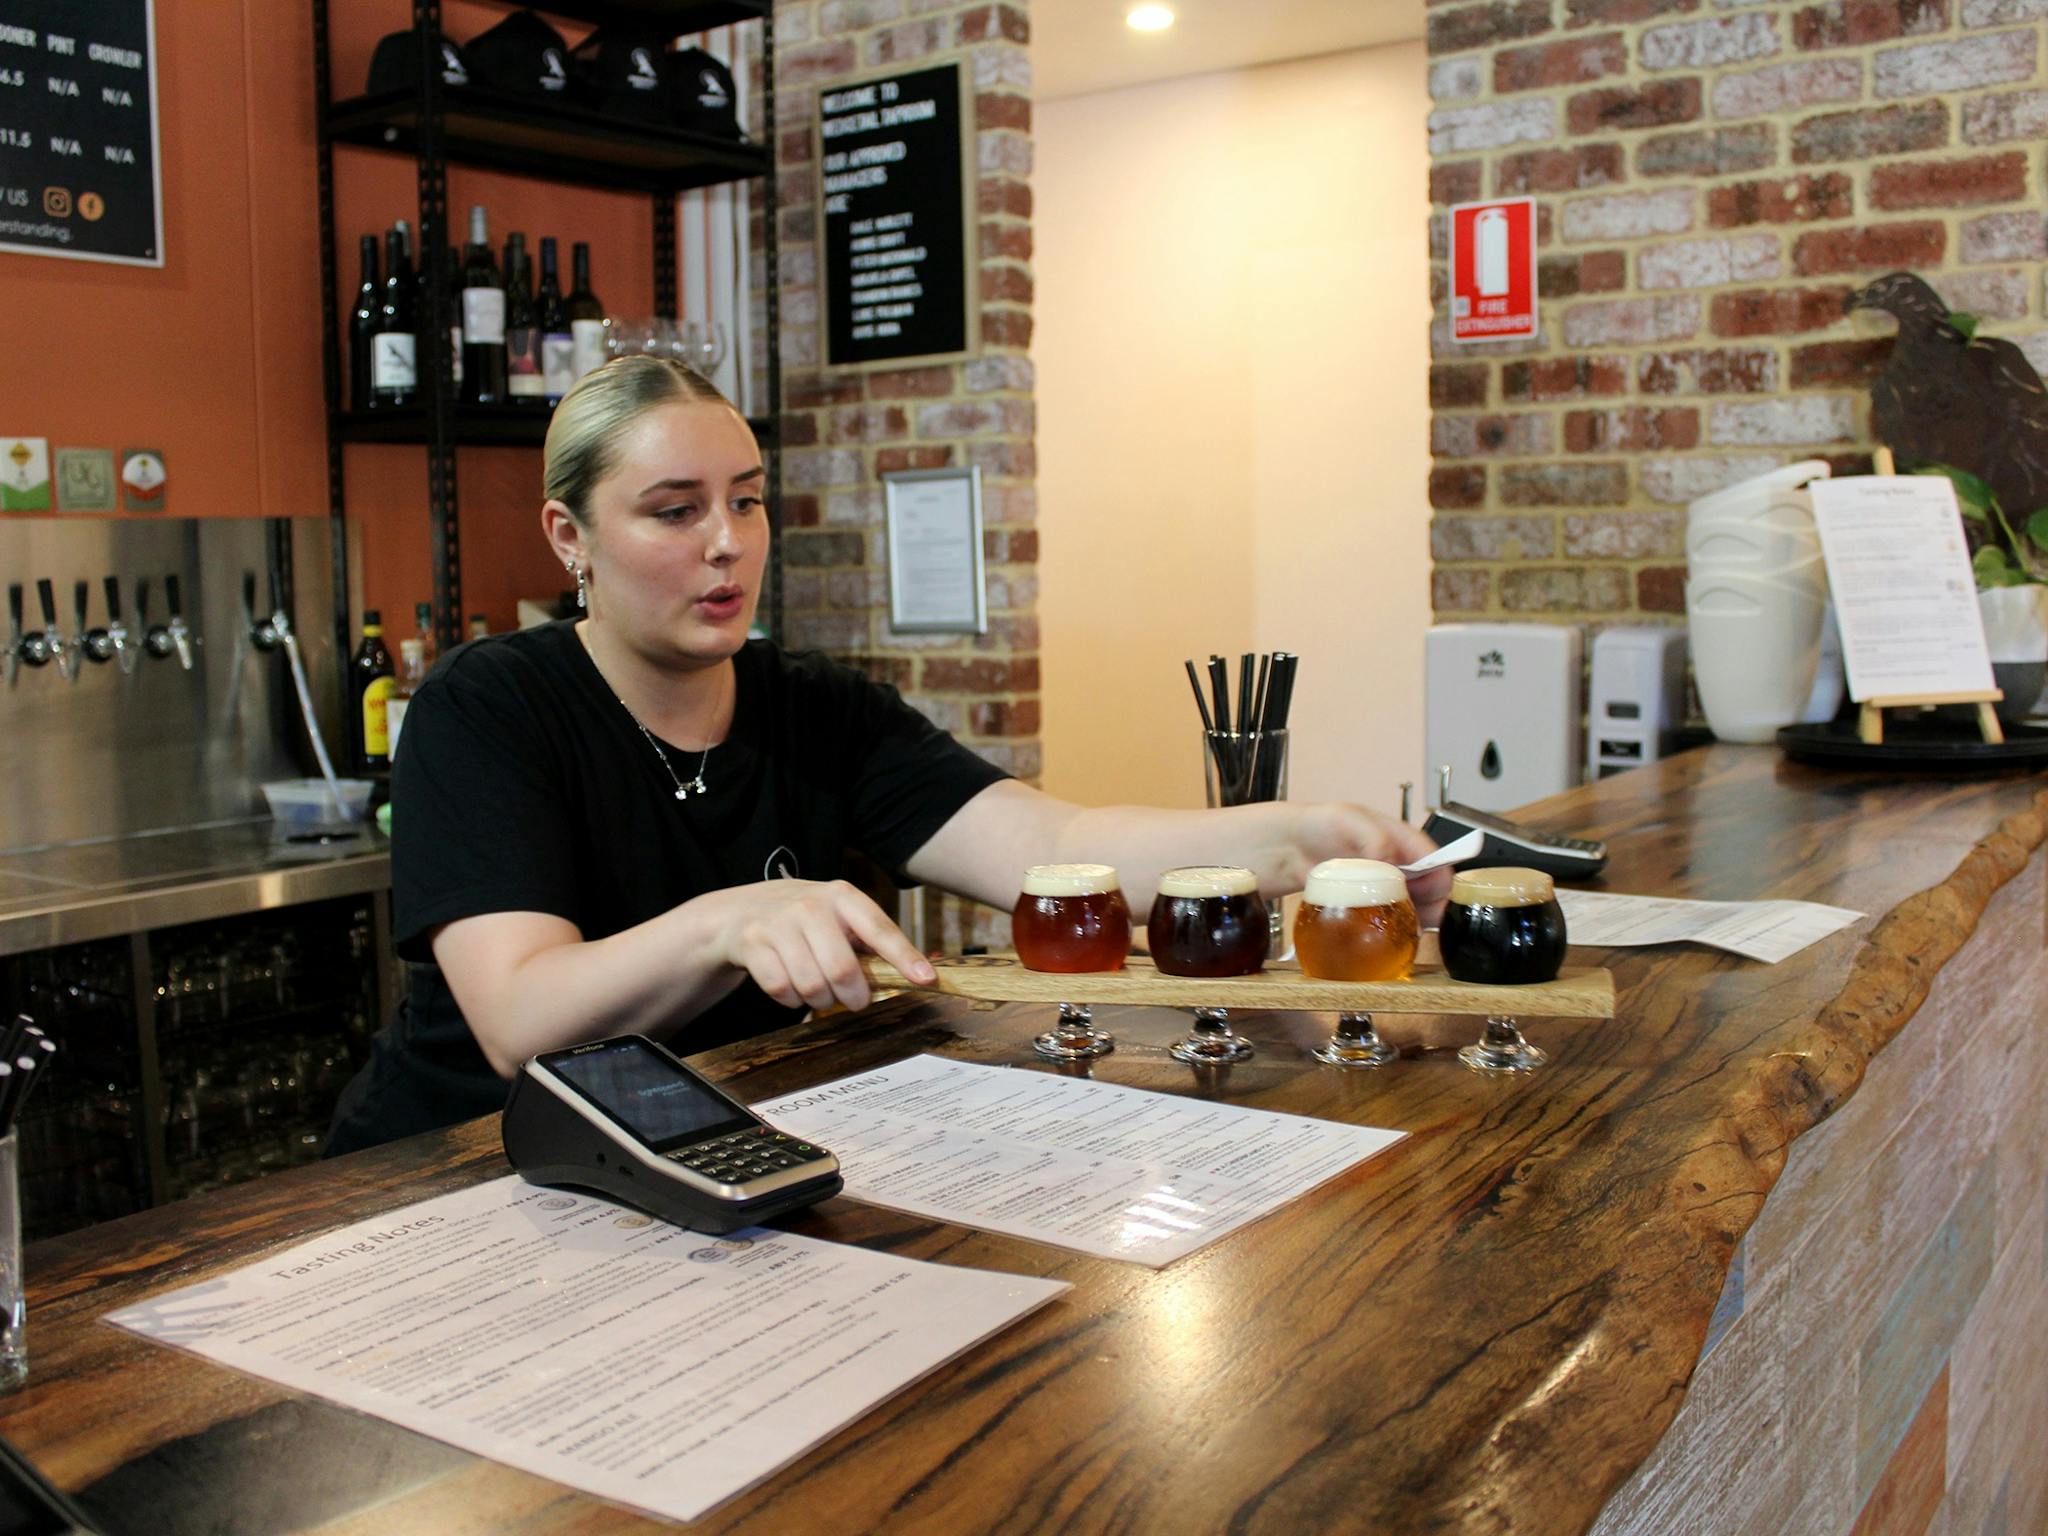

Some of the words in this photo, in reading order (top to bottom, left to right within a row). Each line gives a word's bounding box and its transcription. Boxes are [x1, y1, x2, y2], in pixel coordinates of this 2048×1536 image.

[48, 76, 80, 97] N/A
[102, 86, 133, 107] N/A
[50, 136, 82, 156] N/A
[104, 145, 136, 164] N/A
[1477, 299, 1508, 315] FIRE
[1456, 314, 1531, 334] EXTINGUISHER
[572, 1044, 605, 1055] Verifone
[767, 1089, 833, 1116] ROOM
[833, 1075, 889, 1097] MENU
[270, 1239, 375, 1281] Tasting
[367, 1214, 446, 1245] Notes
